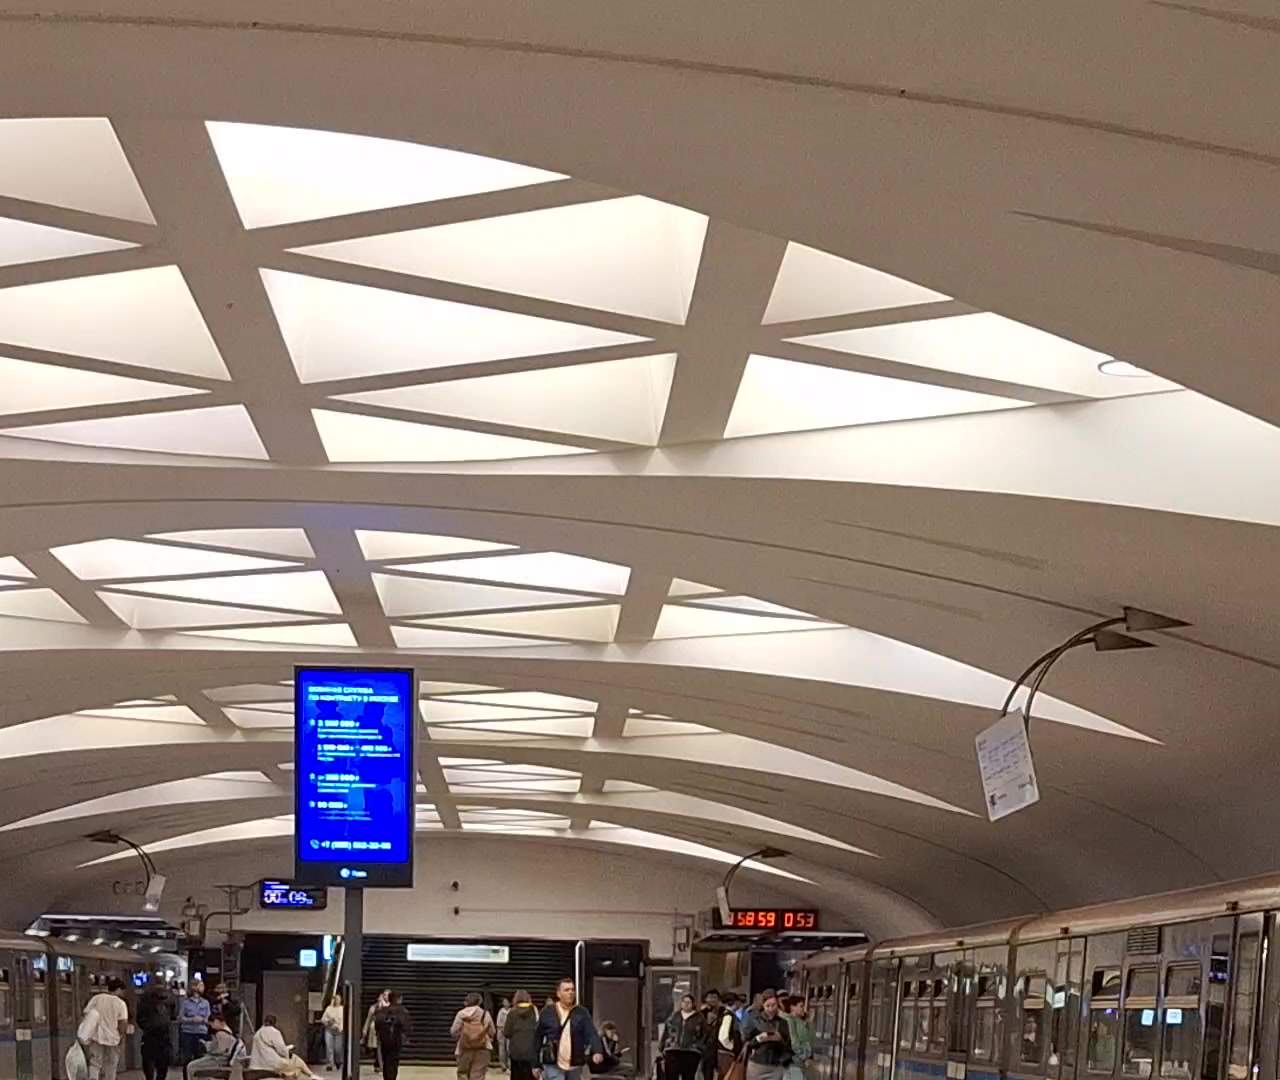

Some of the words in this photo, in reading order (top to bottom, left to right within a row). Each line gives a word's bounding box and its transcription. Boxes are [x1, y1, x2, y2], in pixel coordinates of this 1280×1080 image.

[737, 912, 754, 926] 58
[757, 912, 776, 926] 59
[784, 912, 793, 927] 0
